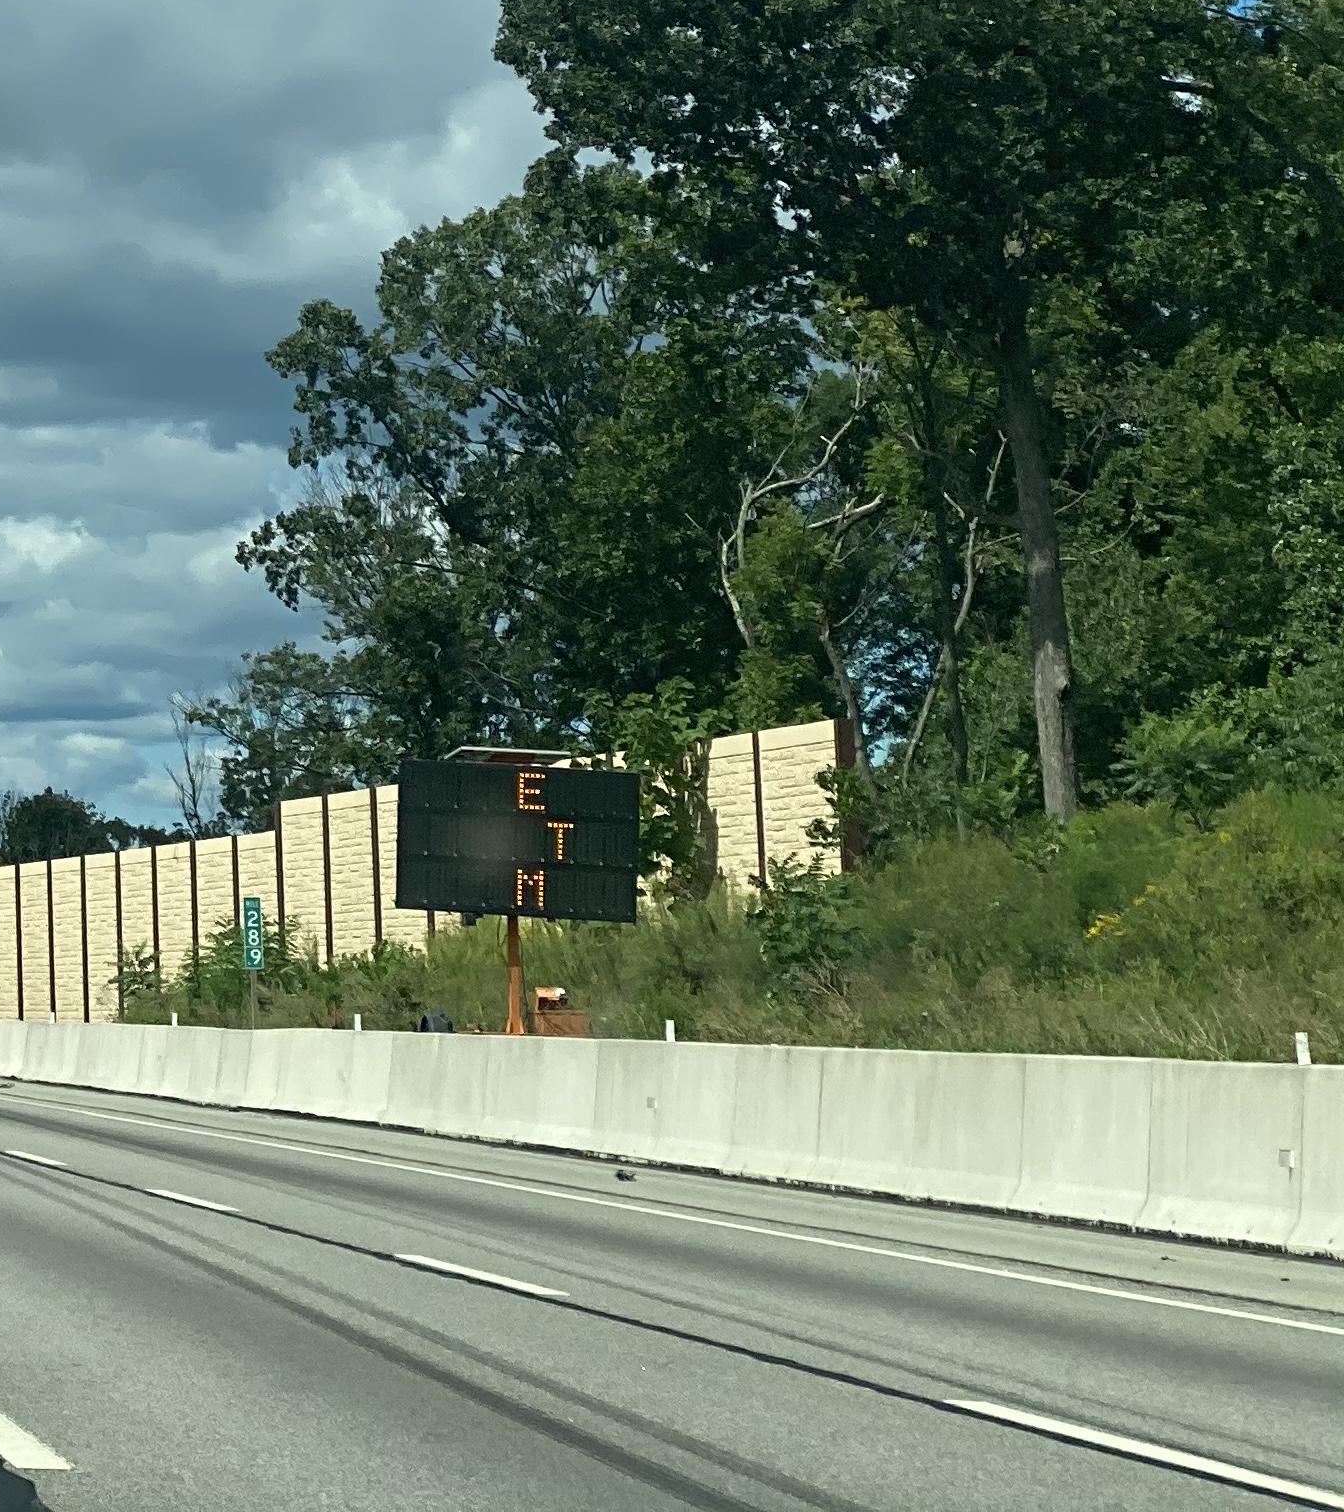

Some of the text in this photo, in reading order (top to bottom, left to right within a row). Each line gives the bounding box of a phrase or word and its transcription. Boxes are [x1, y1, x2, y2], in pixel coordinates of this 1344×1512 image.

[518, 771, 546, 811] E
[547, 821, 574, 860] T
[516, 868, 545, 907] M
